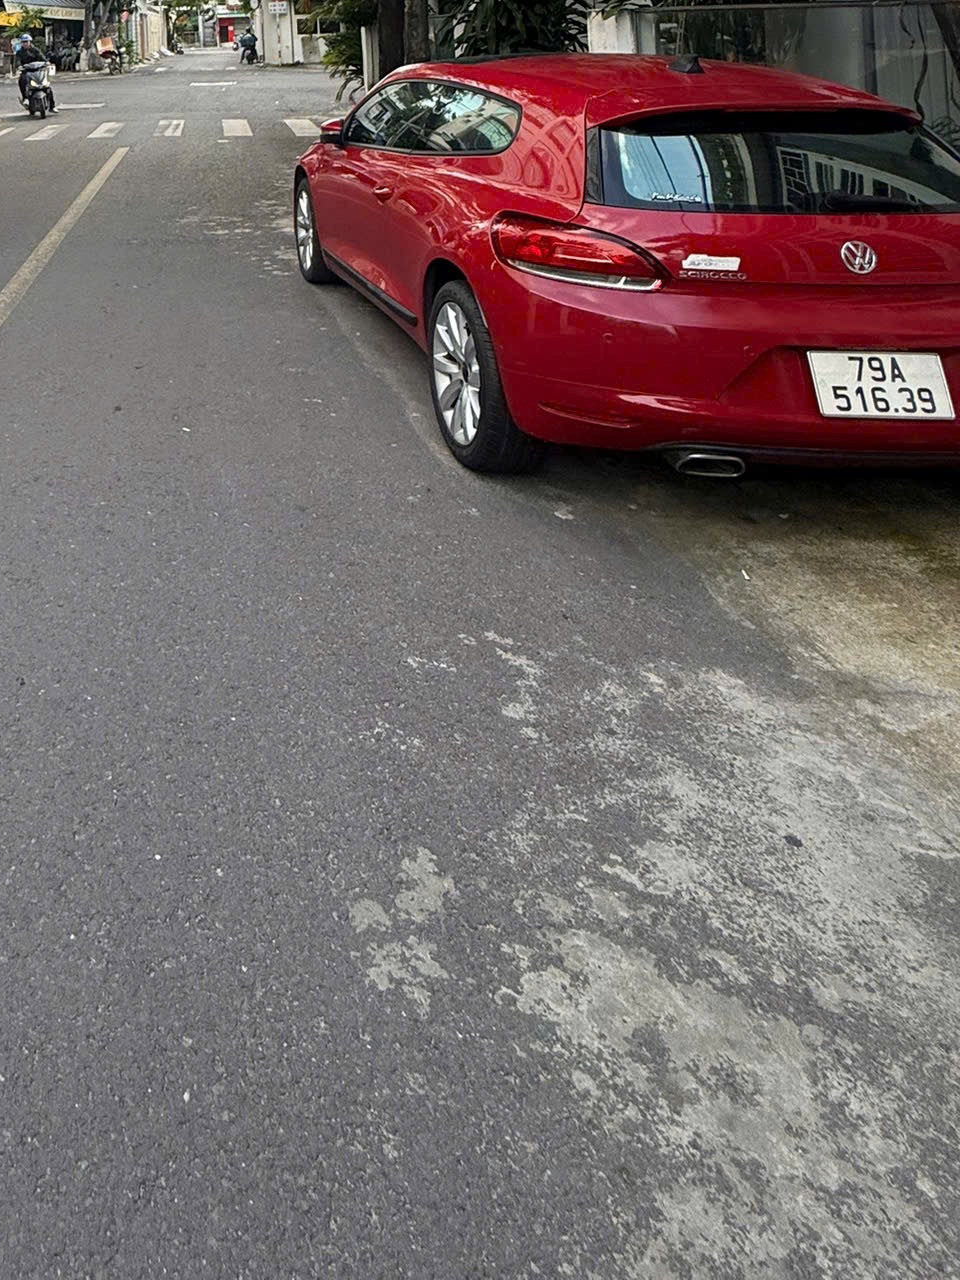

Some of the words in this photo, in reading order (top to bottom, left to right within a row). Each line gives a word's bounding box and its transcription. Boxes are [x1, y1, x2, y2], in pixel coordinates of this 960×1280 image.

[679, 270, 747, 280] SCIROCCO
[847, 356, 906, 382] 79A
[832, 386, 936, 413] 516.39
